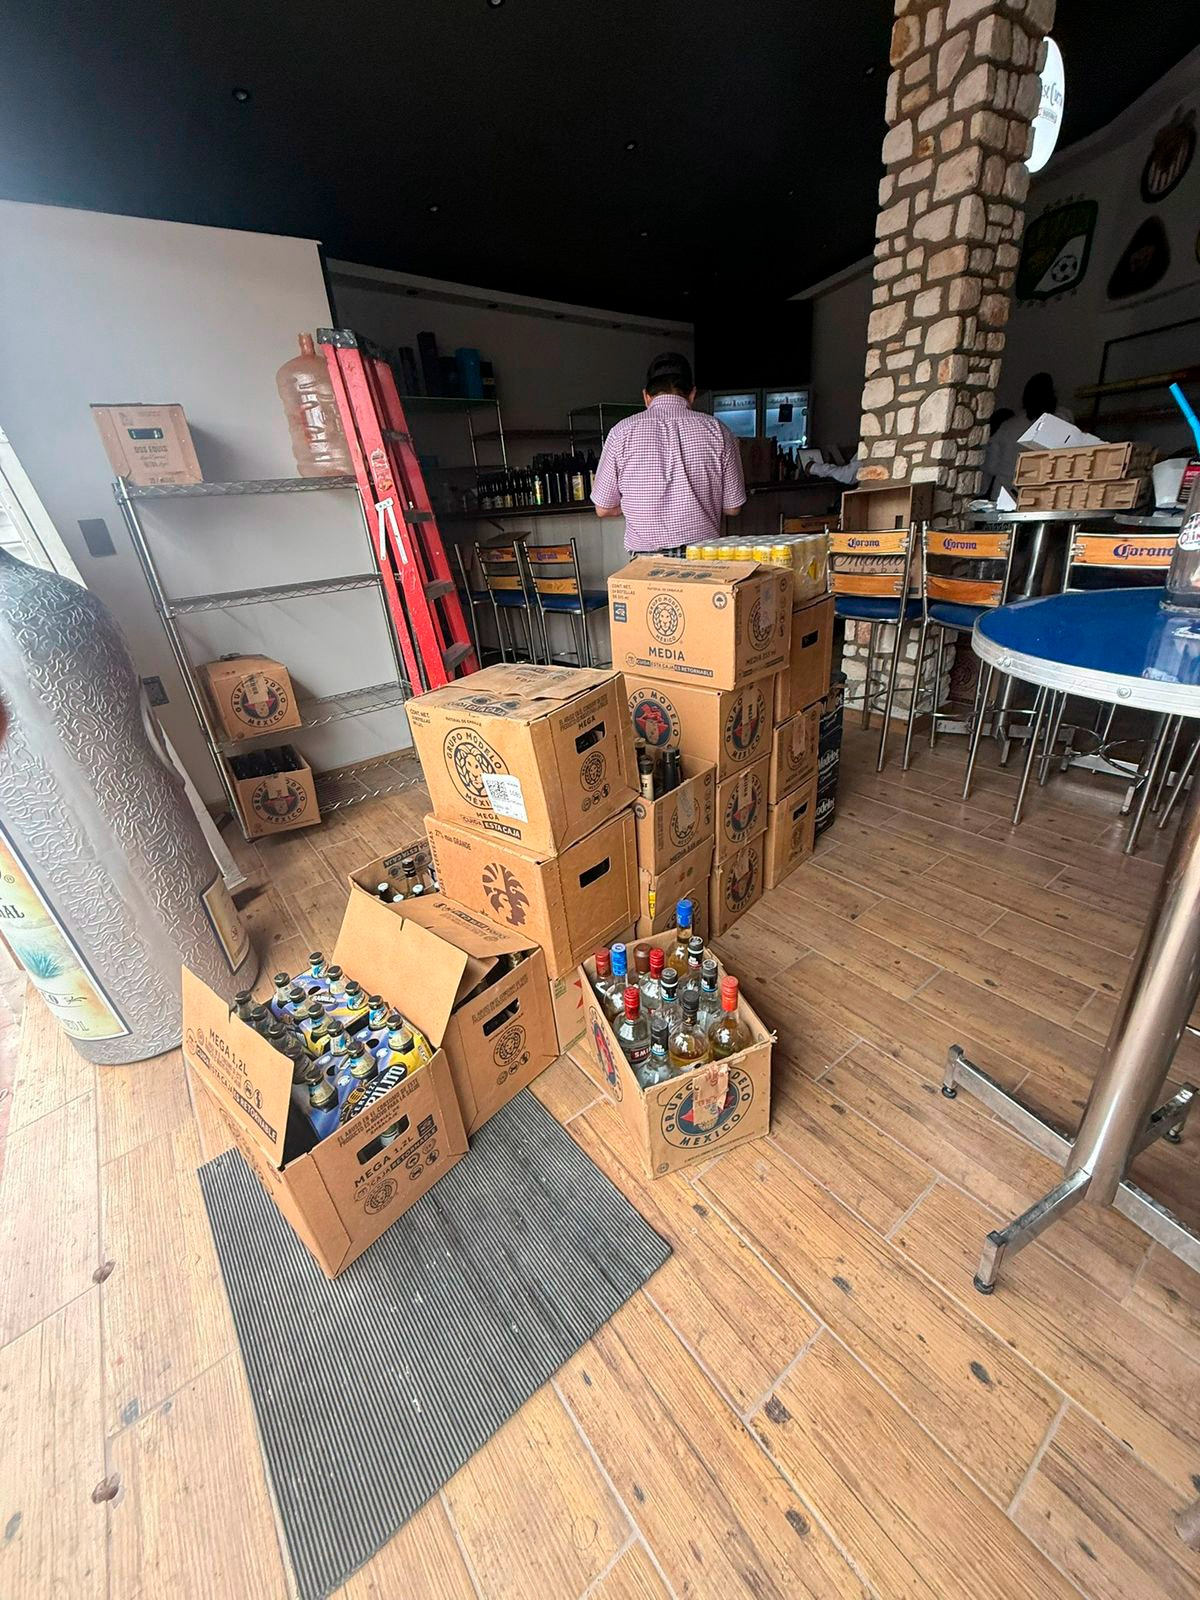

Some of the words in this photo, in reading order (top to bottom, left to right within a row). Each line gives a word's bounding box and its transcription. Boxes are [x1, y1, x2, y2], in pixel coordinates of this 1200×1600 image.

[847, 537, 880, 549] Corona
[943, 537, 977, 551] Corona
[649, 597, 662, 615] GRUPO
[663, 597, 682, 618] MODELO
[648, 646, 686, 661] MEDIA
[681, 666, 713, 677] RETORNABLE
[247, 709, 284, 727] MEXICO
[628, 691, 644, 709] UPO
[650, 690, 679, 737] MODELO
[578, 715, 596, 731] MEGA
[447, 732, 463, 759] GRUPO
[465, 732, 502, 769] MODELO
[465, 793, 491, 807] MEXI
[266, 806, 302, 824] MEXICO
[476, 812, 500, 821] MEGA
[484, 821, 502, 832] ESTA
[501, 824, 521, 839] CAJA
[209, 1028, 230, 1060] MEGA
[731, 1071, 751, 1102] DELO
[680, 1113, 741, 1147] MEXICO
[354, 1155, 391, 1188] MEGA
[370, 1168, 391, 1186] CAJA
